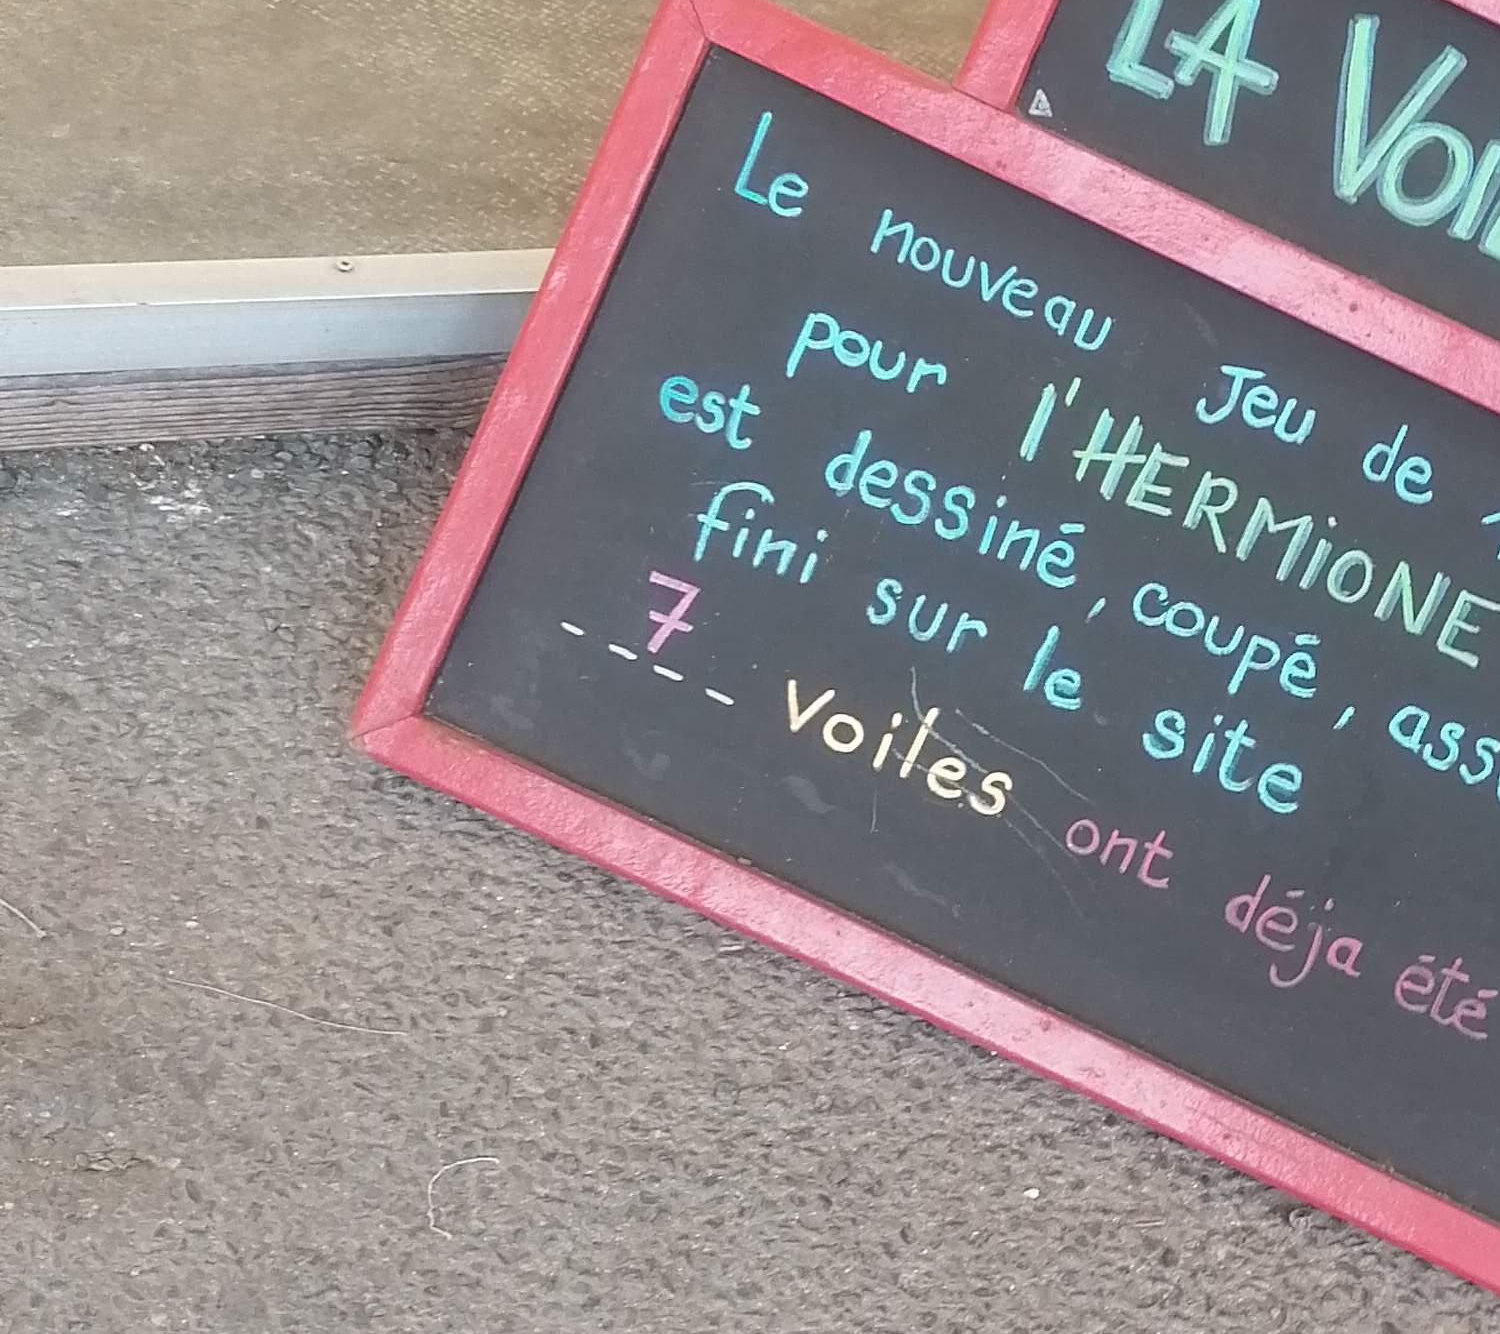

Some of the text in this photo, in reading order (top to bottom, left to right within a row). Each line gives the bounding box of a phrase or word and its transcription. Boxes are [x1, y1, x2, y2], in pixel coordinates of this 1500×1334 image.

[658, 375, 761, 451] est
[734, 111, 809, 219] Le
[869, 208, 1114, 352] nouveau
[1361, 423, 1434, 504] de
[786, 311, 947, 394] pour
[649, 569, 700, 653] 7
[1065, 818, 1173, 889] ont
[1393, 954, 1499, 1041] été
[693, 481, 1302, 813] fini sur le site
